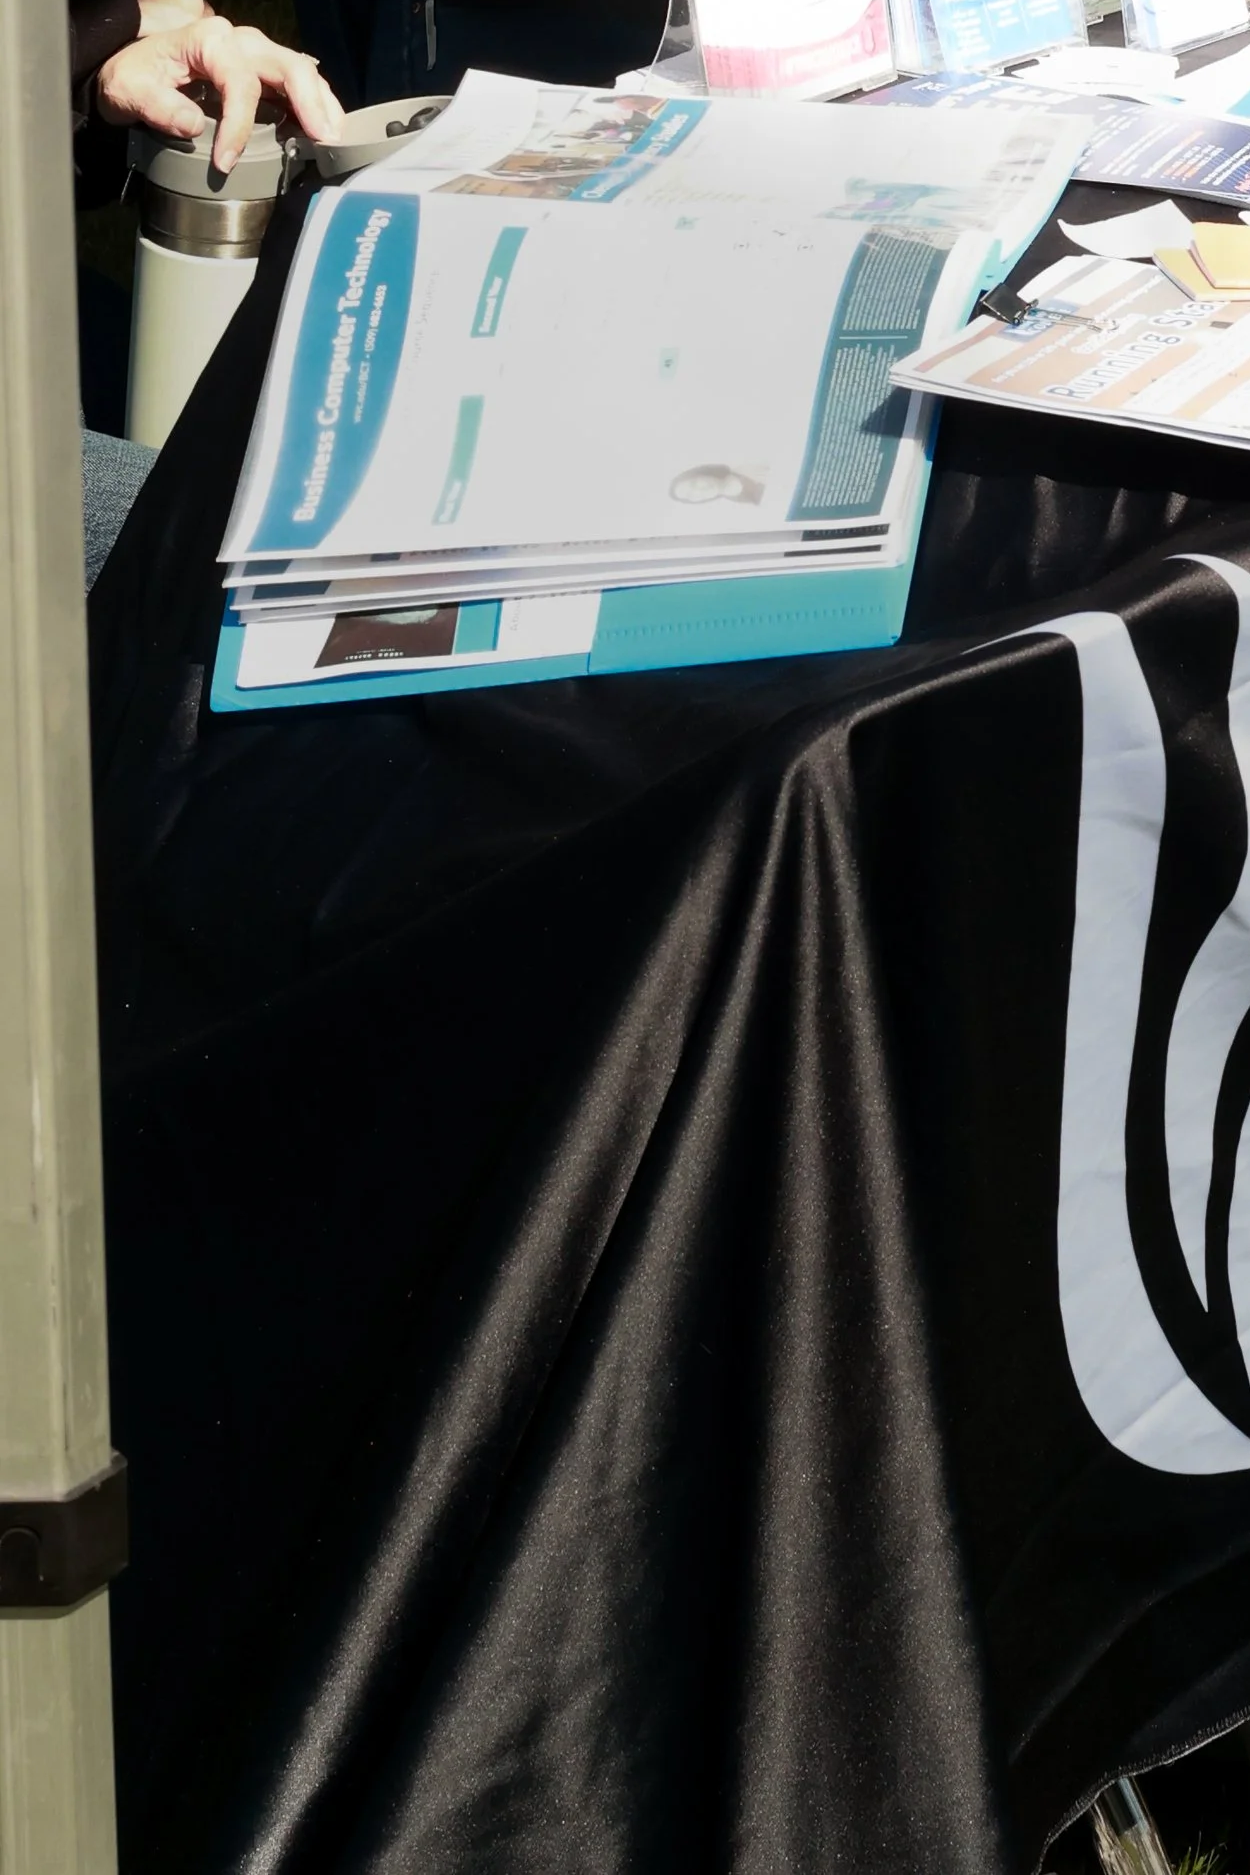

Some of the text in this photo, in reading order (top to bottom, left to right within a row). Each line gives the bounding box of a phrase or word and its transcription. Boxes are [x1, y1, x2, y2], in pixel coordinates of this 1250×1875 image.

[293, 208, 393, 523] Business Computer Technology
[1039, 330, 1188, 401] Running
[1147, 298, 1230, 331] Sta
